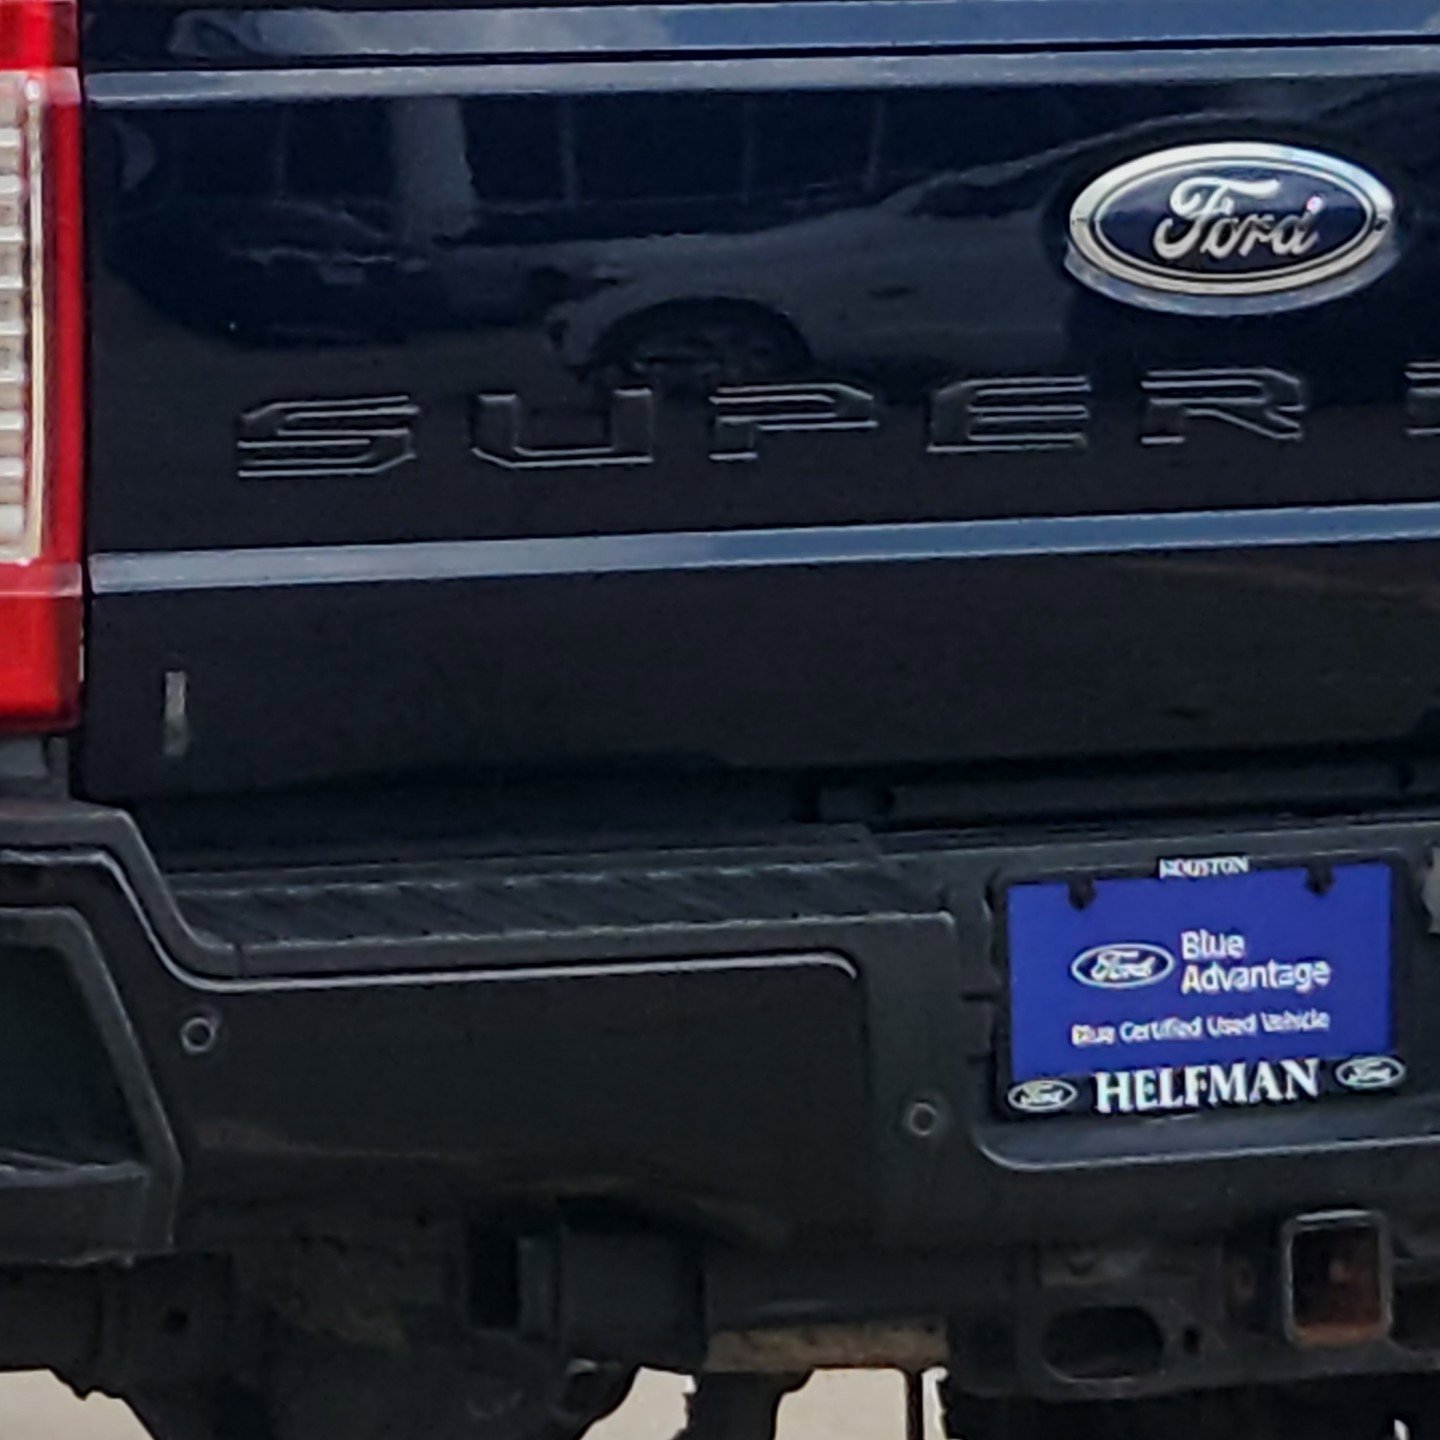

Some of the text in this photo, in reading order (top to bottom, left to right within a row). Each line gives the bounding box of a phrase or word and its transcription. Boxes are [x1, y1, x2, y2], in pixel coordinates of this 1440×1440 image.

[1154, 175, 1324, 259] Ford
[237, 363, 1307, 480] SUPER
[1180, 928, 1246, 960] Blue
[1180, 959, 1332, 995] Advantage
[1071, 1023, 1116, 1045] Blue
[1120, 1015, 1204, 1041] Certified
[1206, 1013, 1257, 1038] Used
[1093, 1057, 1321, 1114] HELFMAN
